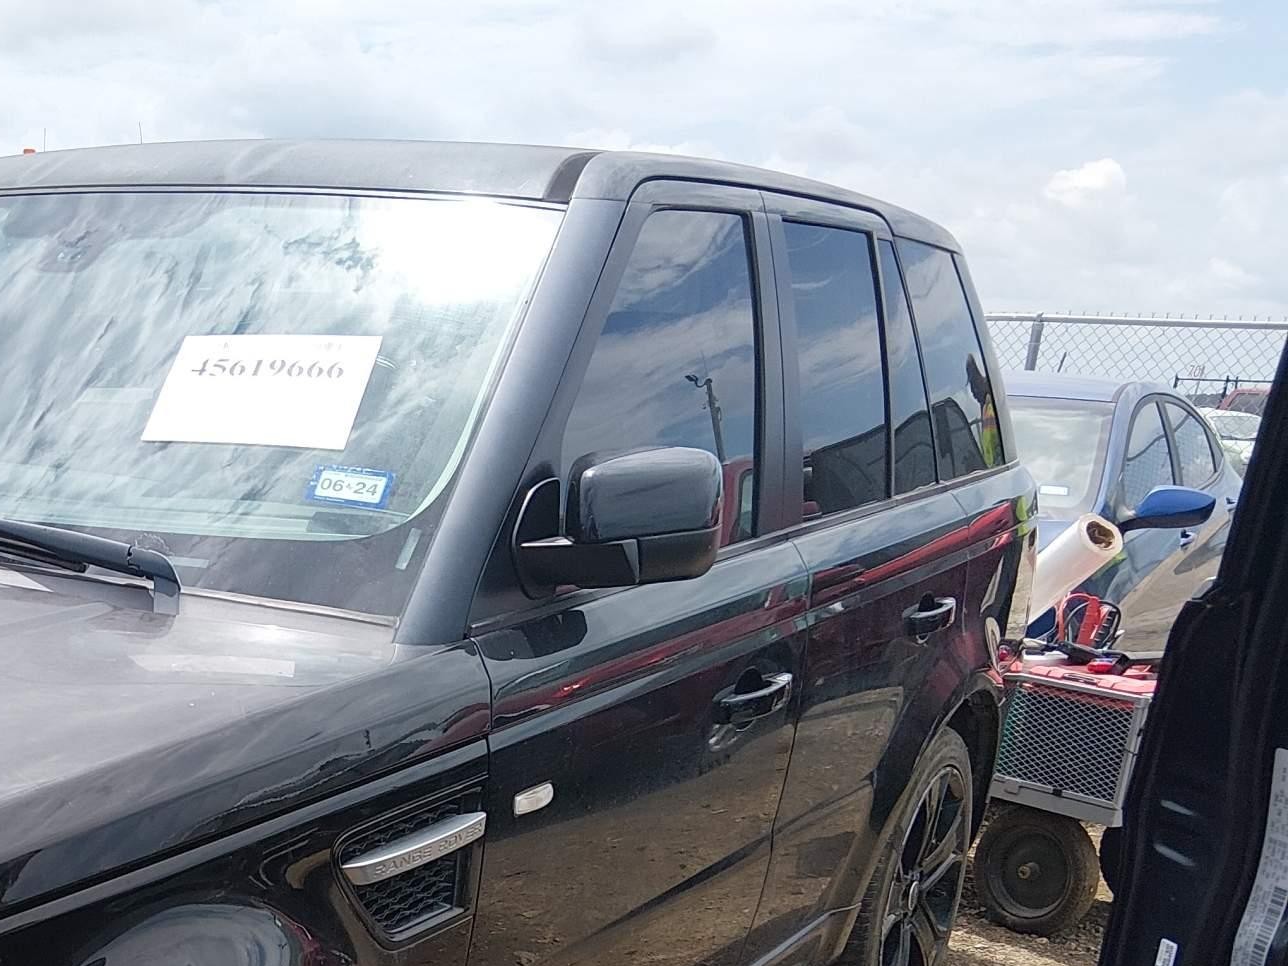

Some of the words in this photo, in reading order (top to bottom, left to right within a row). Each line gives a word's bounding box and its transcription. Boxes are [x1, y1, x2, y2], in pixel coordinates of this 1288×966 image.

[191, 358, 345, 379] 45619666
[320, 478, 345, 492] 06
[352, 481, 379, 496] 24
[375, 845, 433, 875] RANGE
[439, 822, 483, 852] ROVER
